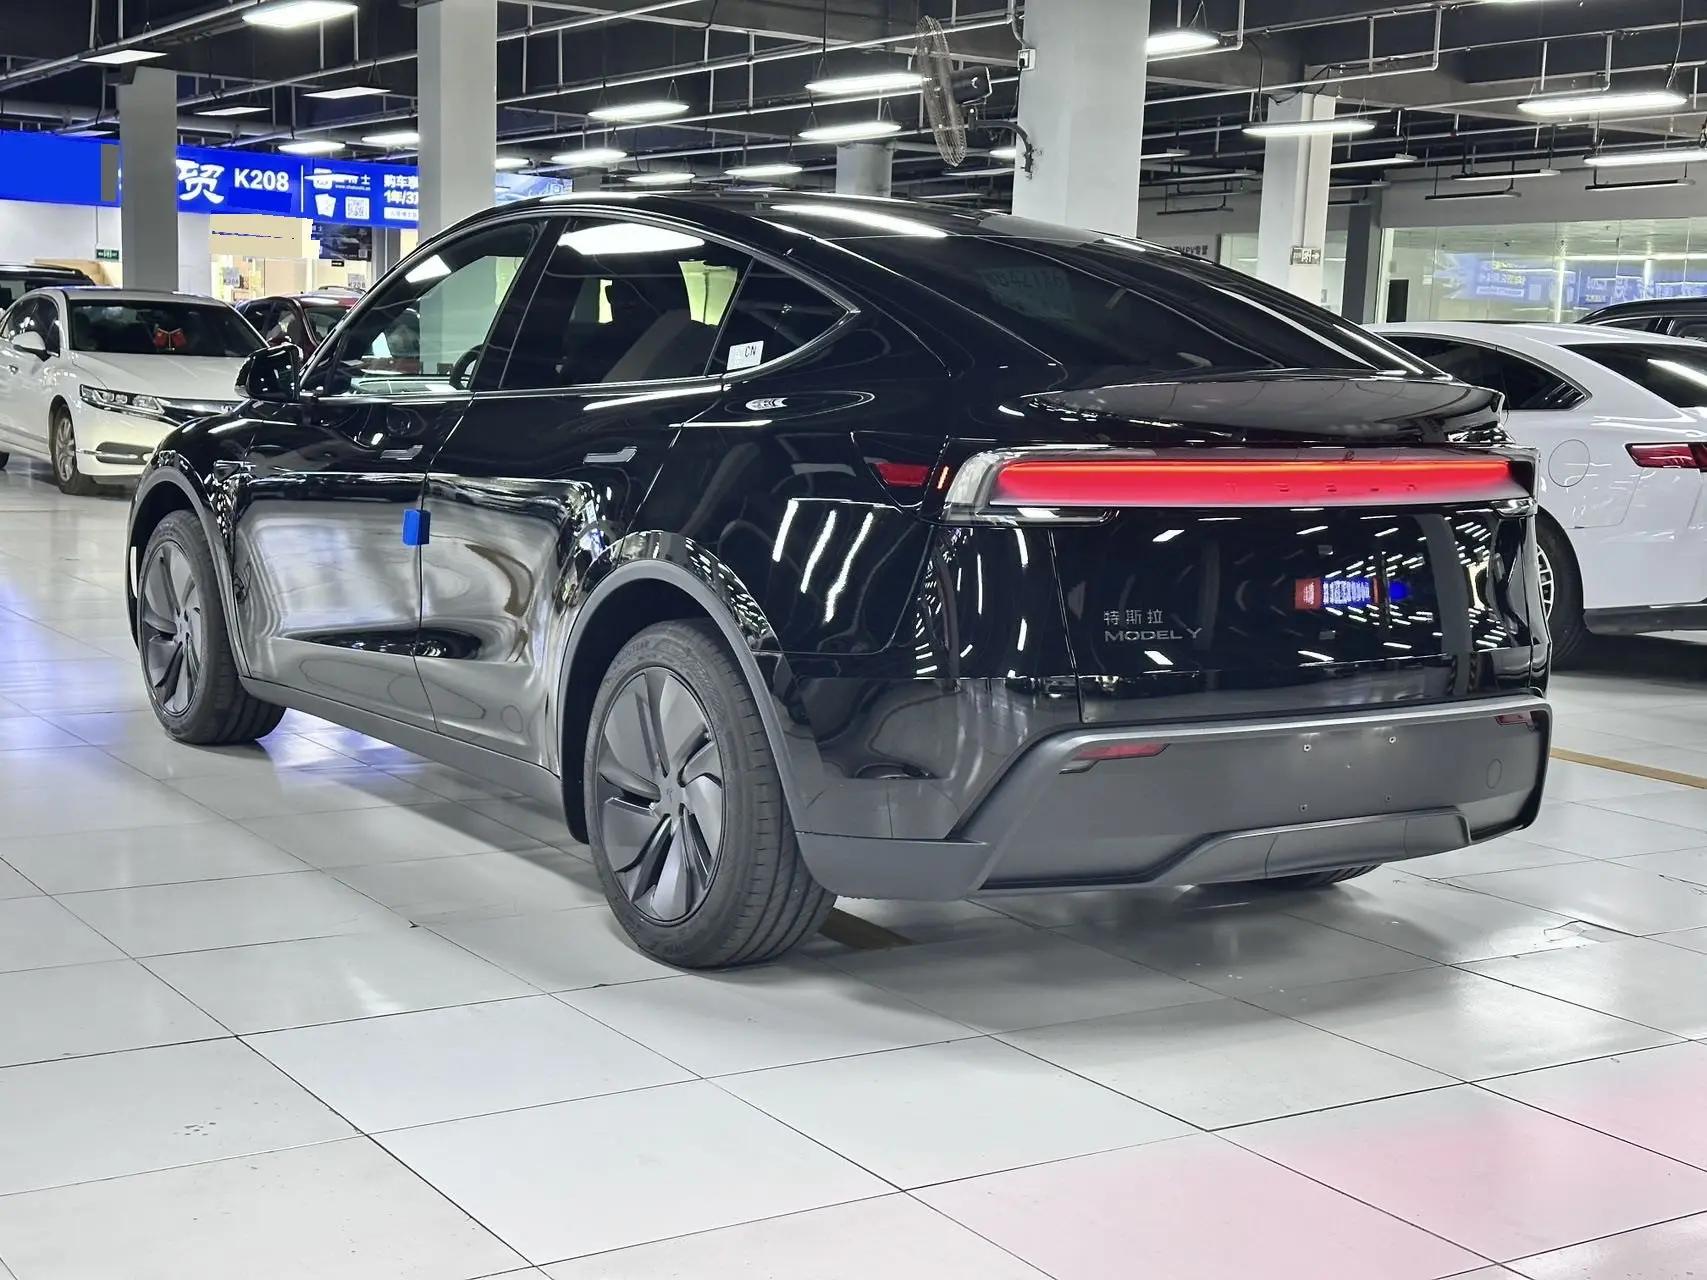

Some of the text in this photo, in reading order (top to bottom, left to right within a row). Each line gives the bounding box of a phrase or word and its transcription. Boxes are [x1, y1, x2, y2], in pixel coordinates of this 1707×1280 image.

[234, 167, 290, 193] K208
[744, 345, 757, 358] CN
[1103, 608, 1164, 626] 特斯拉
[1104, 627, 1203, 642] MODEL Y
